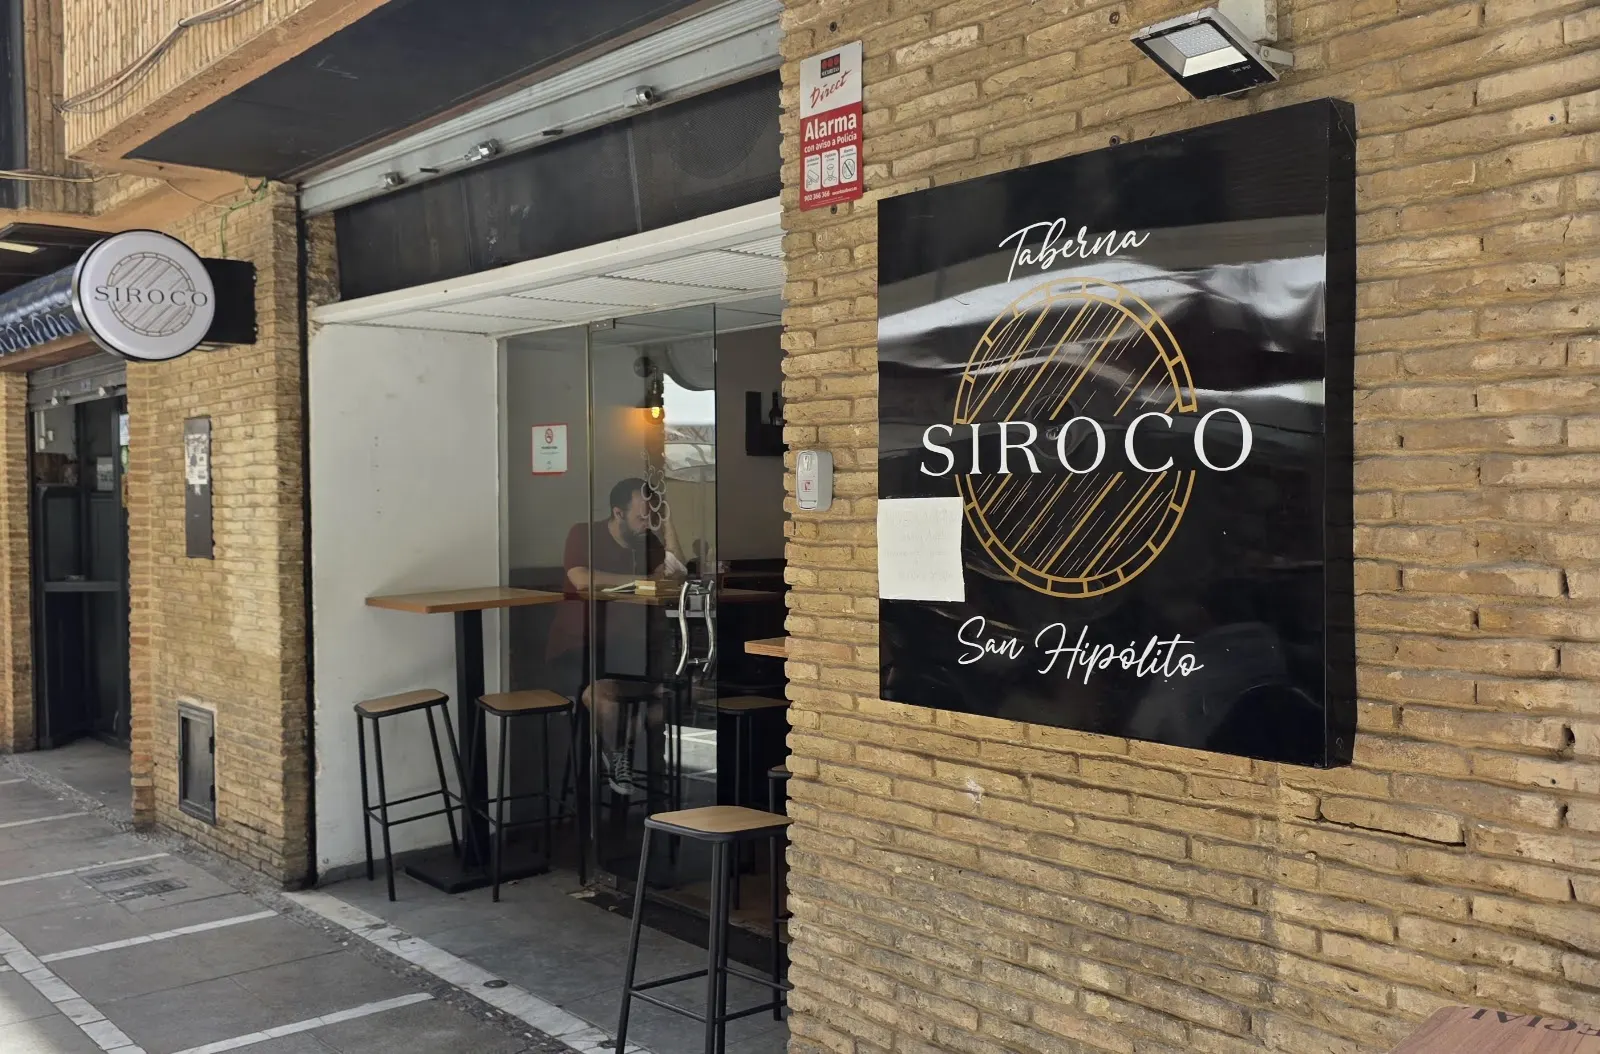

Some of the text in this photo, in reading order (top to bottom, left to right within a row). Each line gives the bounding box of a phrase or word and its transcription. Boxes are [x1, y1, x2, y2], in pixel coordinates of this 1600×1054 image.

[810, 69, 852, 109] Direct
[804, 113, 857, 142] Alarma
[804, 131, 857, 154] con aviso a Policía
[998, 217, 1150, 283] Taberna
[94, 285, 208, 307] SIROCO
[919, 407, 1253, 477] SIROCO
[957, 615, 1205, 685] San Hipólito
